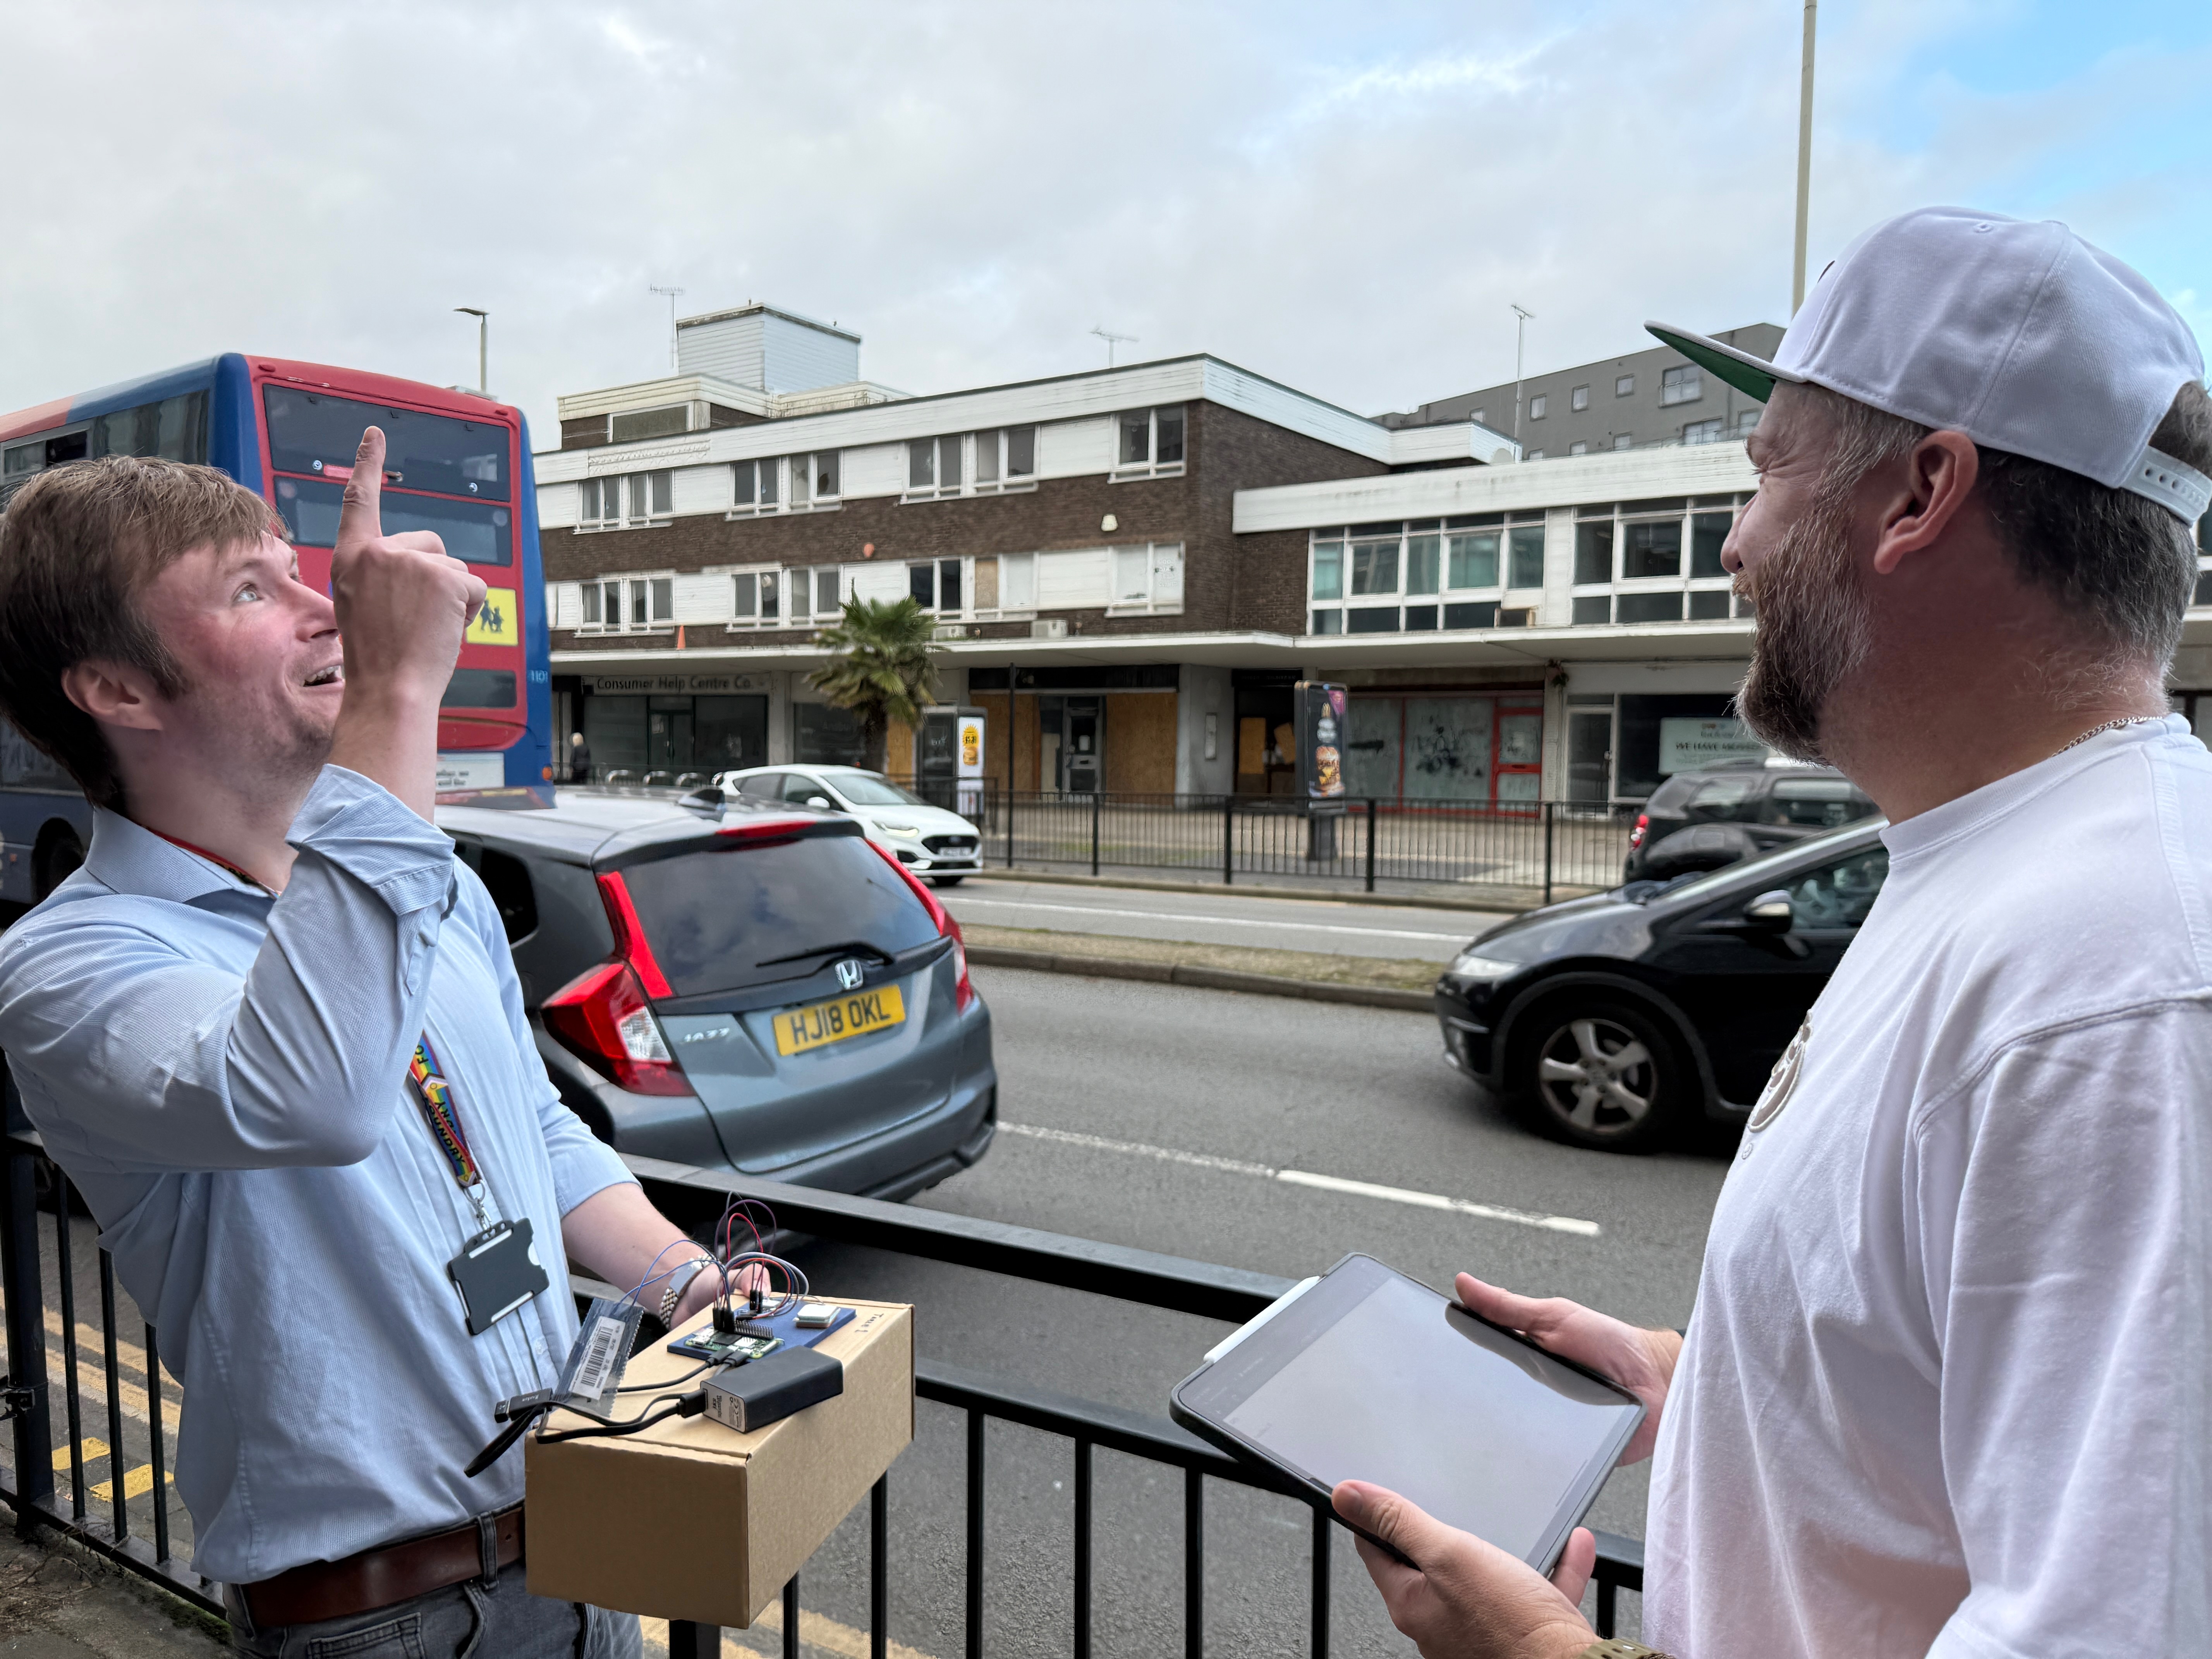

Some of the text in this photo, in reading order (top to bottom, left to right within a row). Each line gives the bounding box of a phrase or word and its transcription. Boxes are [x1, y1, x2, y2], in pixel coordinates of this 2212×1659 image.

[597, 676, 654, 690] Consumer
[659, 675, 685, 694] Help
[690, 675, 729, 689] Centre
[848, 994, 891, 1028] OKL
